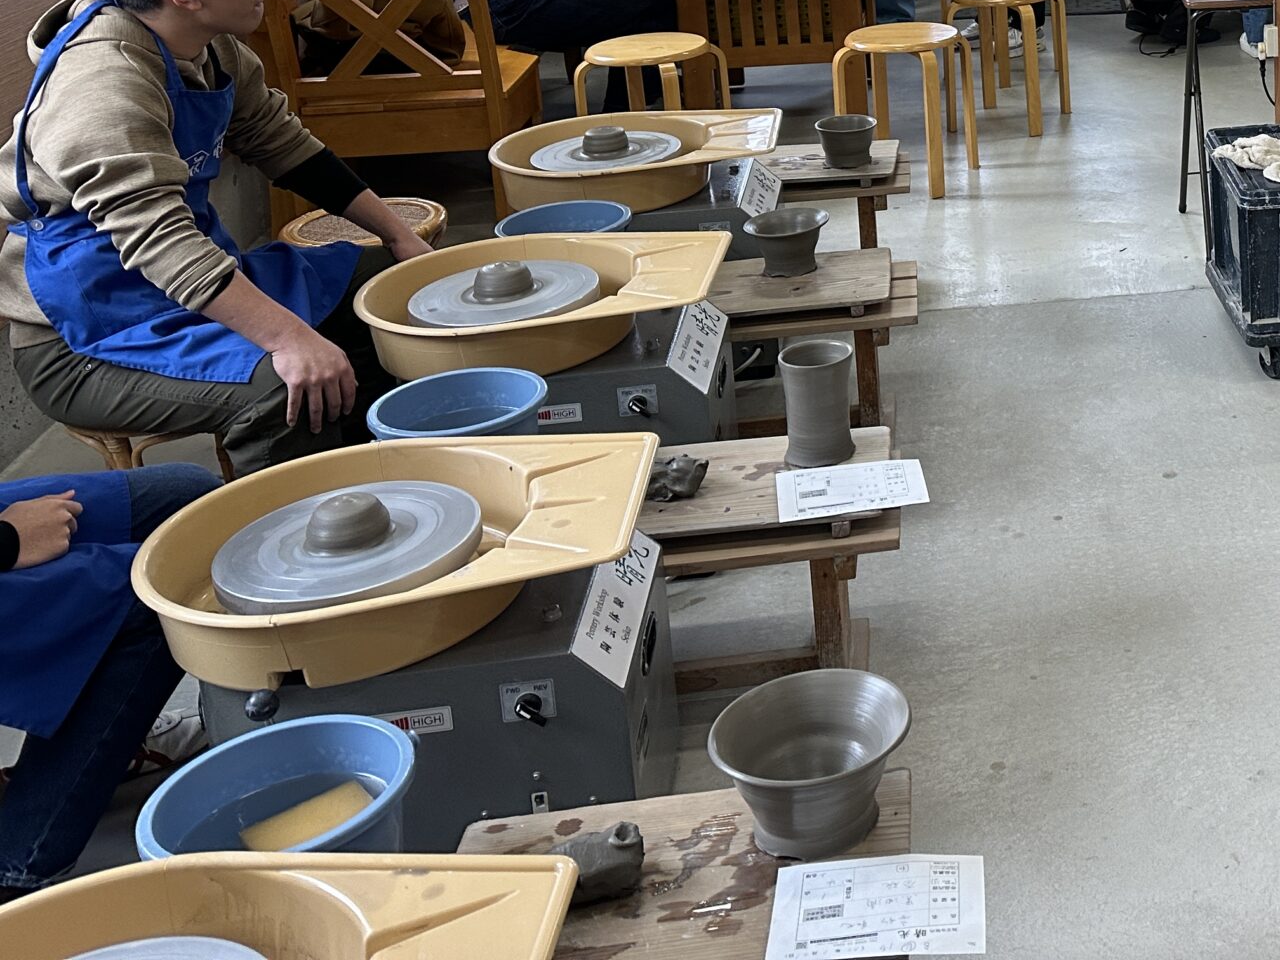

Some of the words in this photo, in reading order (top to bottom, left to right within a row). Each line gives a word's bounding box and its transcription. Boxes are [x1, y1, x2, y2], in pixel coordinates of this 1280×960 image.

[691, 303, 721, 337] 晴光
[553, 409, 575, 418] HIGH
[592, 588, 610, 619] Workshop
[585, 618, 600, 640] Pottery
[620, 625, 632, 644] Seiko
[505, 686, 521, 694] FWD
[533, 683, 548, 691] REV
[412, 714, 442, 727] HIGH
[898, 928, 927, 939] 晴光
